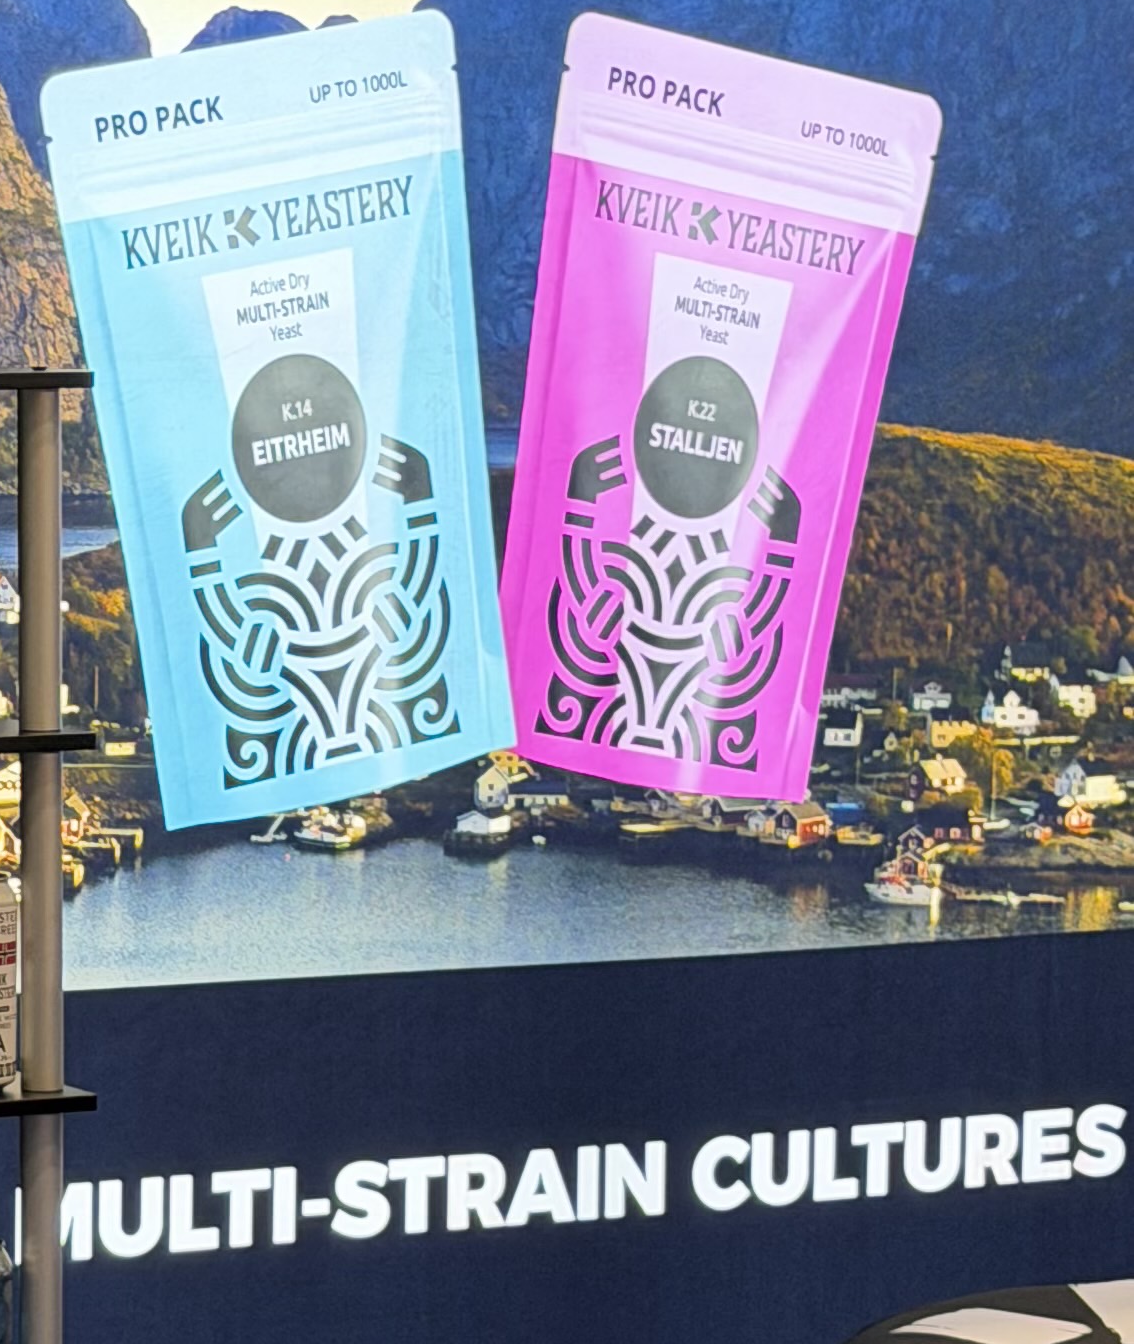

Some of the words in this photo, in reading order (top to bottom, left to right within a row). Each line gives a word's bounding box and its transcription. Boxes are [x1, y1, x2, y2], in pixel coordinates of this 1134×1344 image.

[95, 111, 147, 142] PRO
[155, 96, 223, 132] PACK
[309, 85, 331, 104] UP
[335, 79, 357, 99] TO
[364, 70, 408, 94] 1000L
[607, 67, 656, 99] PRO
[662, 83, 725, 117] PACK
[801, 121, 823, 138] UP
[825, 126, 846, 145] TO
[849, 132, 889, 157] 1000L
[120, 214, 219, 269] KVEIK
[262, 175, 414, 242] YEASTERY
[594, 180, 684, 236] KVEIK
[726, 210, 866, 276] YEASTERY
[250, 275, 287, 297] Active
[288, 273, 310, 293] Dry
[693, 276, 727, 300] Active
[729, 283, 750, 306] Dry
[236, 292, 330, 326] MULTI-STRAIN
[674, 296, 761, 329] MULTI-STRAIN
[269, 323, 303, 344] Yeast
[700, 325, 730, 345] Yeast
[281, 398, 313, 422] K.14
[251, 422, 351, 467] EITRHEIM
[649, 422, 744, 464] STALLJEN
[690, 1102, 1127, 1211] CULTURES
